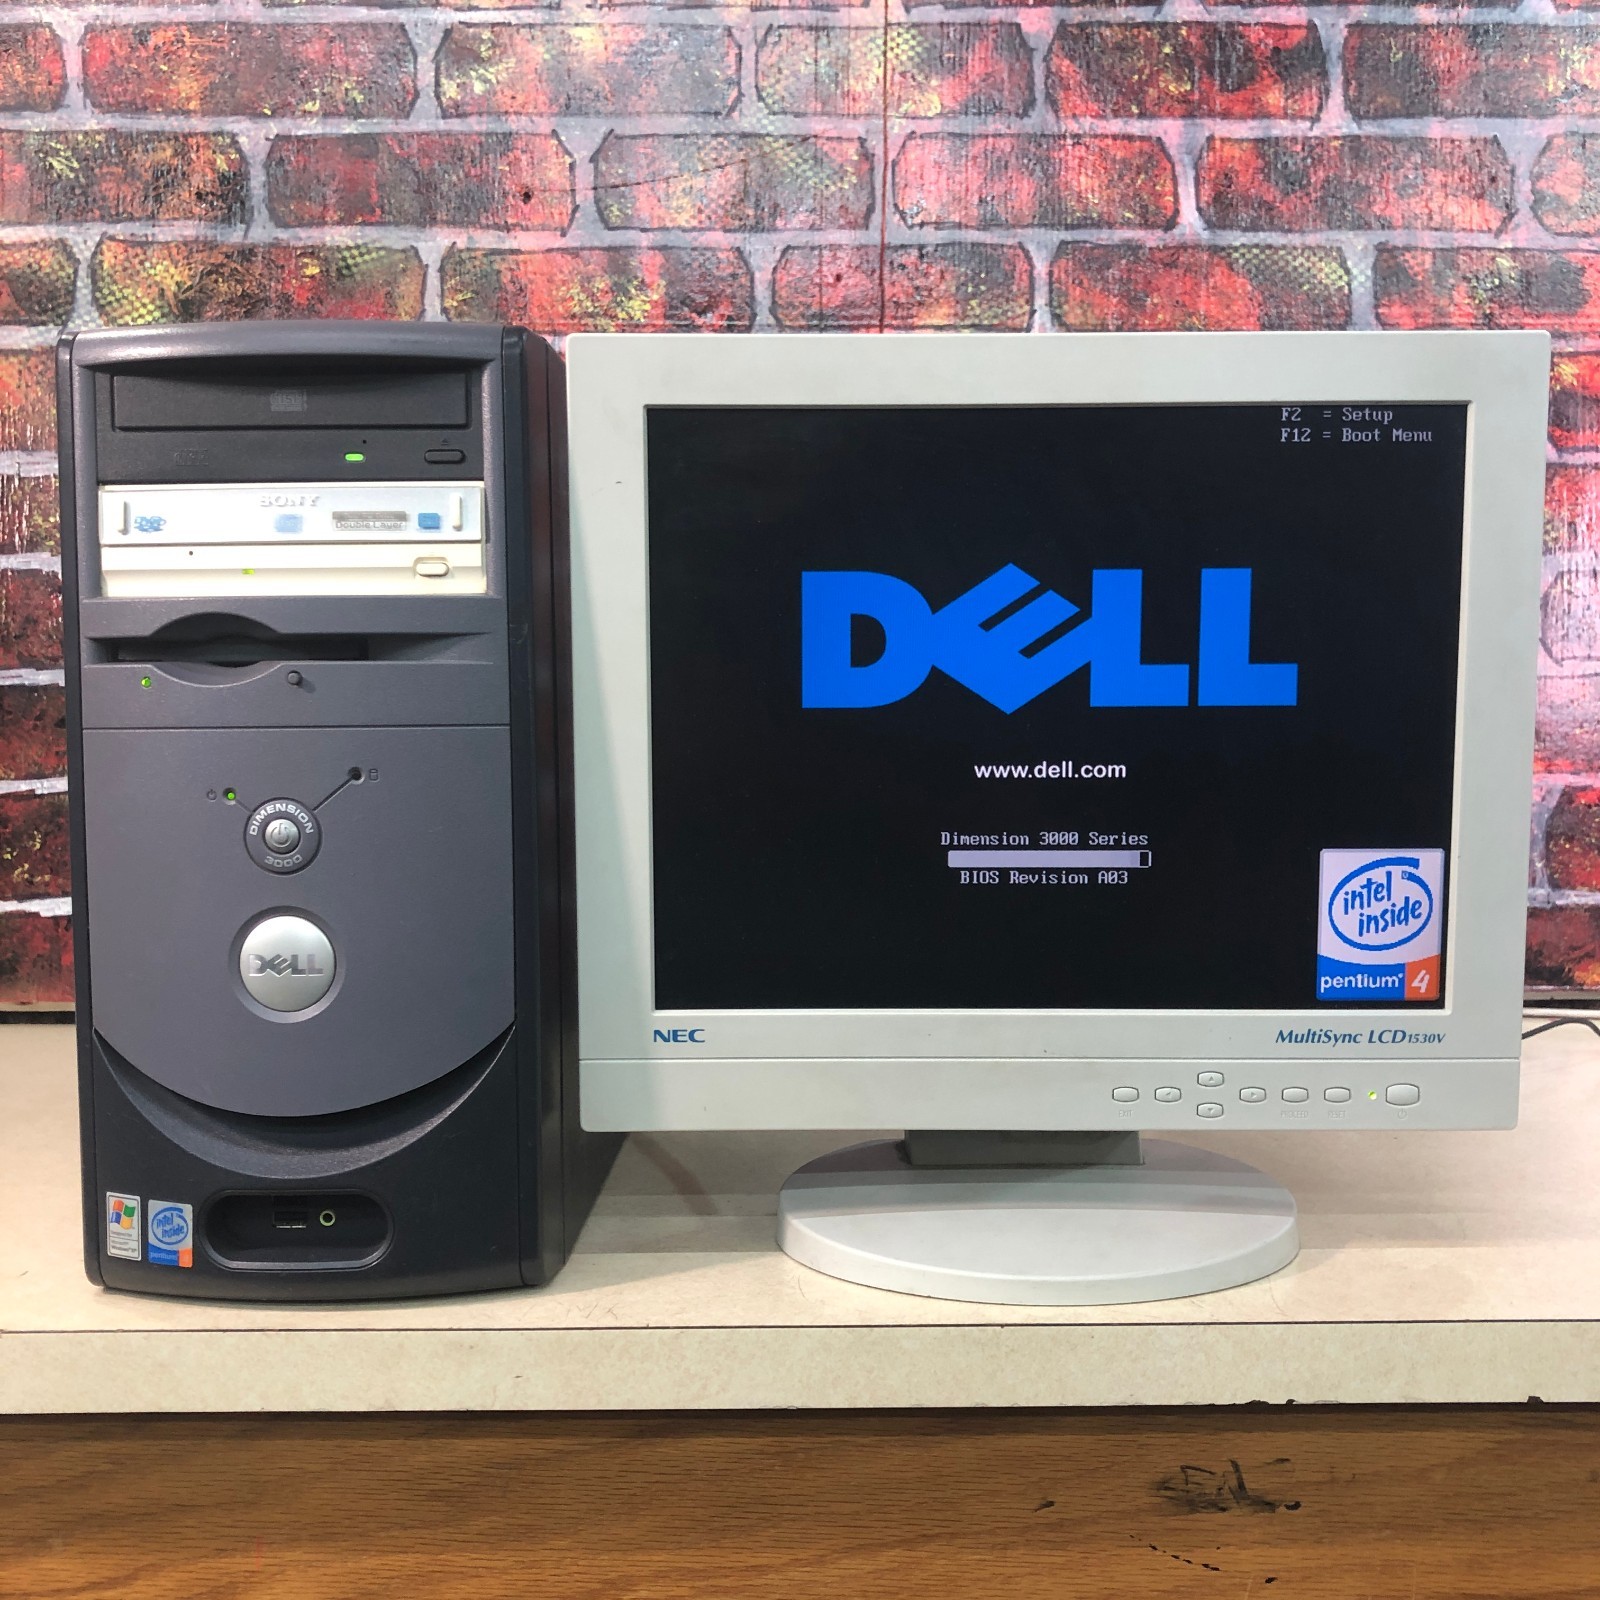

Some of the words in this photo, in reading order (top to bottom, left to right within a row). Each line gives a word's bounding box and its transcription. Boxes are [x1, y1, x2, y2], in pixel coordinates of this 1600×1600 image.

[1280, 407, 1302, 422] F2
[1322, 409, 1333, 419] =
[1341, 407, 1393, 424] Setup
[1280, 427, 1312, 442] F12
[1322, 431, 1332, 439] =
[1341, 428, 1381, 442] Boot
[1392, 428, 1433, 442] Menu
[335, 520, 371, 529] Double
[373, 520, 404, 530] Layer
[801, 562, 1299, 715] DELL
[973, 760, 1128, 779] www.dell.com
[248, 803, 315, 836] DIMENSION
[940, 831, 1030, 846] Dimension
[1039, 831, 1079, 846] 3000
[1088, 831, 1149, 846] Series
[264, 854, 303, 868] 3000
[959, 870, 1000, 885] BIOS
[1009, 870, 1089, 885] Revision
[1097, 870, 1129, 885] A03
[1343, 870, 1393, 916] intel
[1358, 896, 1423, 938] inside
[248, 953, 325, 977] DELL
[1320, 974, 1400, 993] pentium
[1411, 969, 1431, 993] 4
[653, 1028, 706, 1043] NEC
[1275, 1028, 1364, 1047] MultiSync
[1118, 1110, 1134, 1118] EXIT
[156, 1212, 174, 1229] intel
